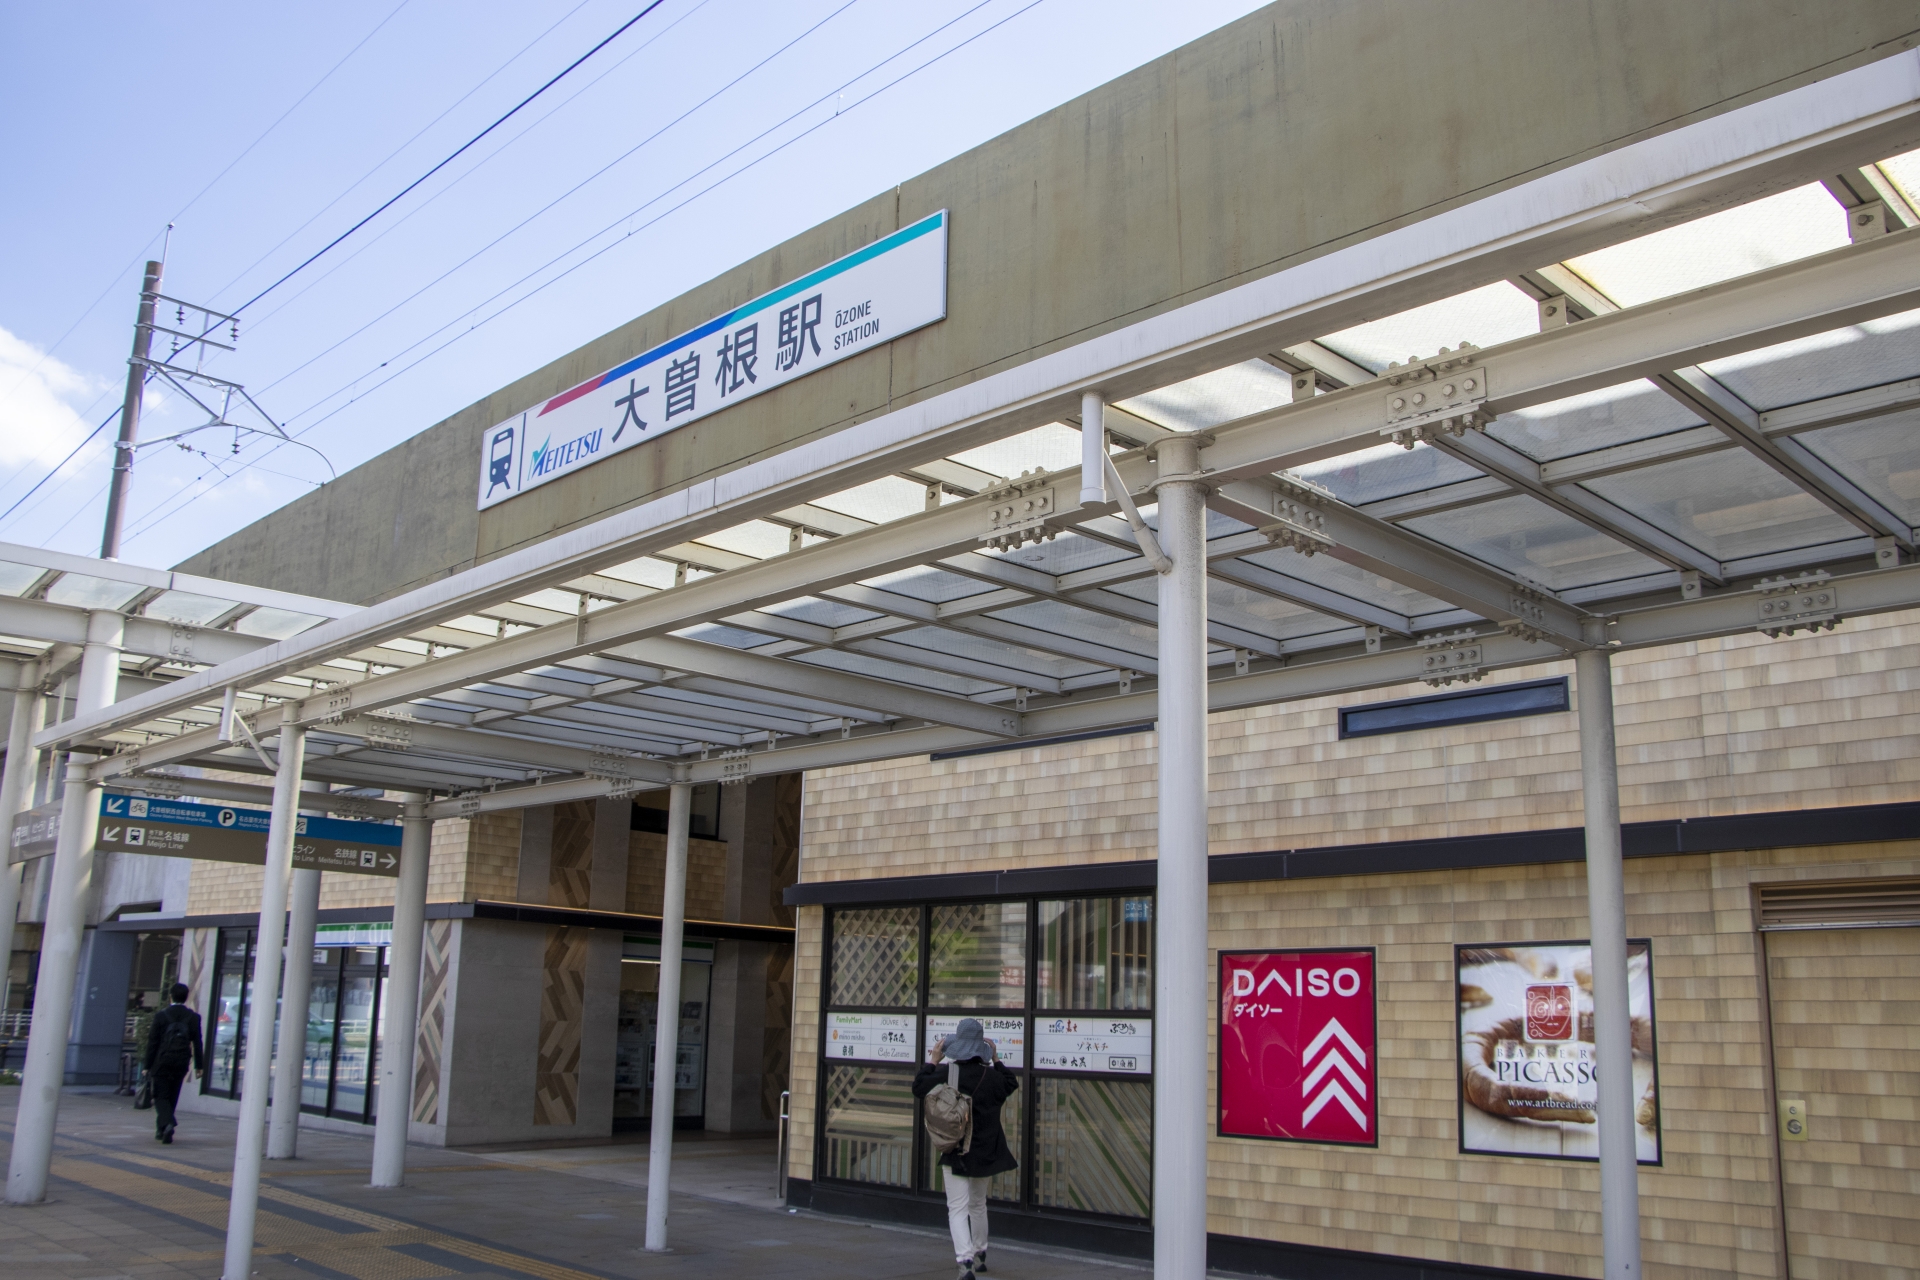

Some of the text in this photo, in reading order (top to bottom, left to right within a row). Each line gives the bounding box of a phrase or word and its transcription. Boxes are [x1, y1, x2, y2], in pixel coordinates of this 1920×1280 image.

[834, 318, 880, 351] STATION
[611, 293, 823, 443] 大曽根駅
[527, 427, 604, 481] MEITETSU
[222, 811, 233, 823] P
[165, 831, 190, 842] 名城線
[147, 840, 184, 849] Meijo Line
[335, 848, 358, 859] 名鉄線
[318, 856, 343, 865] Meitetsu
[1233, 967, 1360, 997] DAISO
[1233, 1002, 1283, 1018] ダイソー
[836, 1016, 863, 1024] FamilyMart
[993, 1020, 1023, 1030] おたからや
